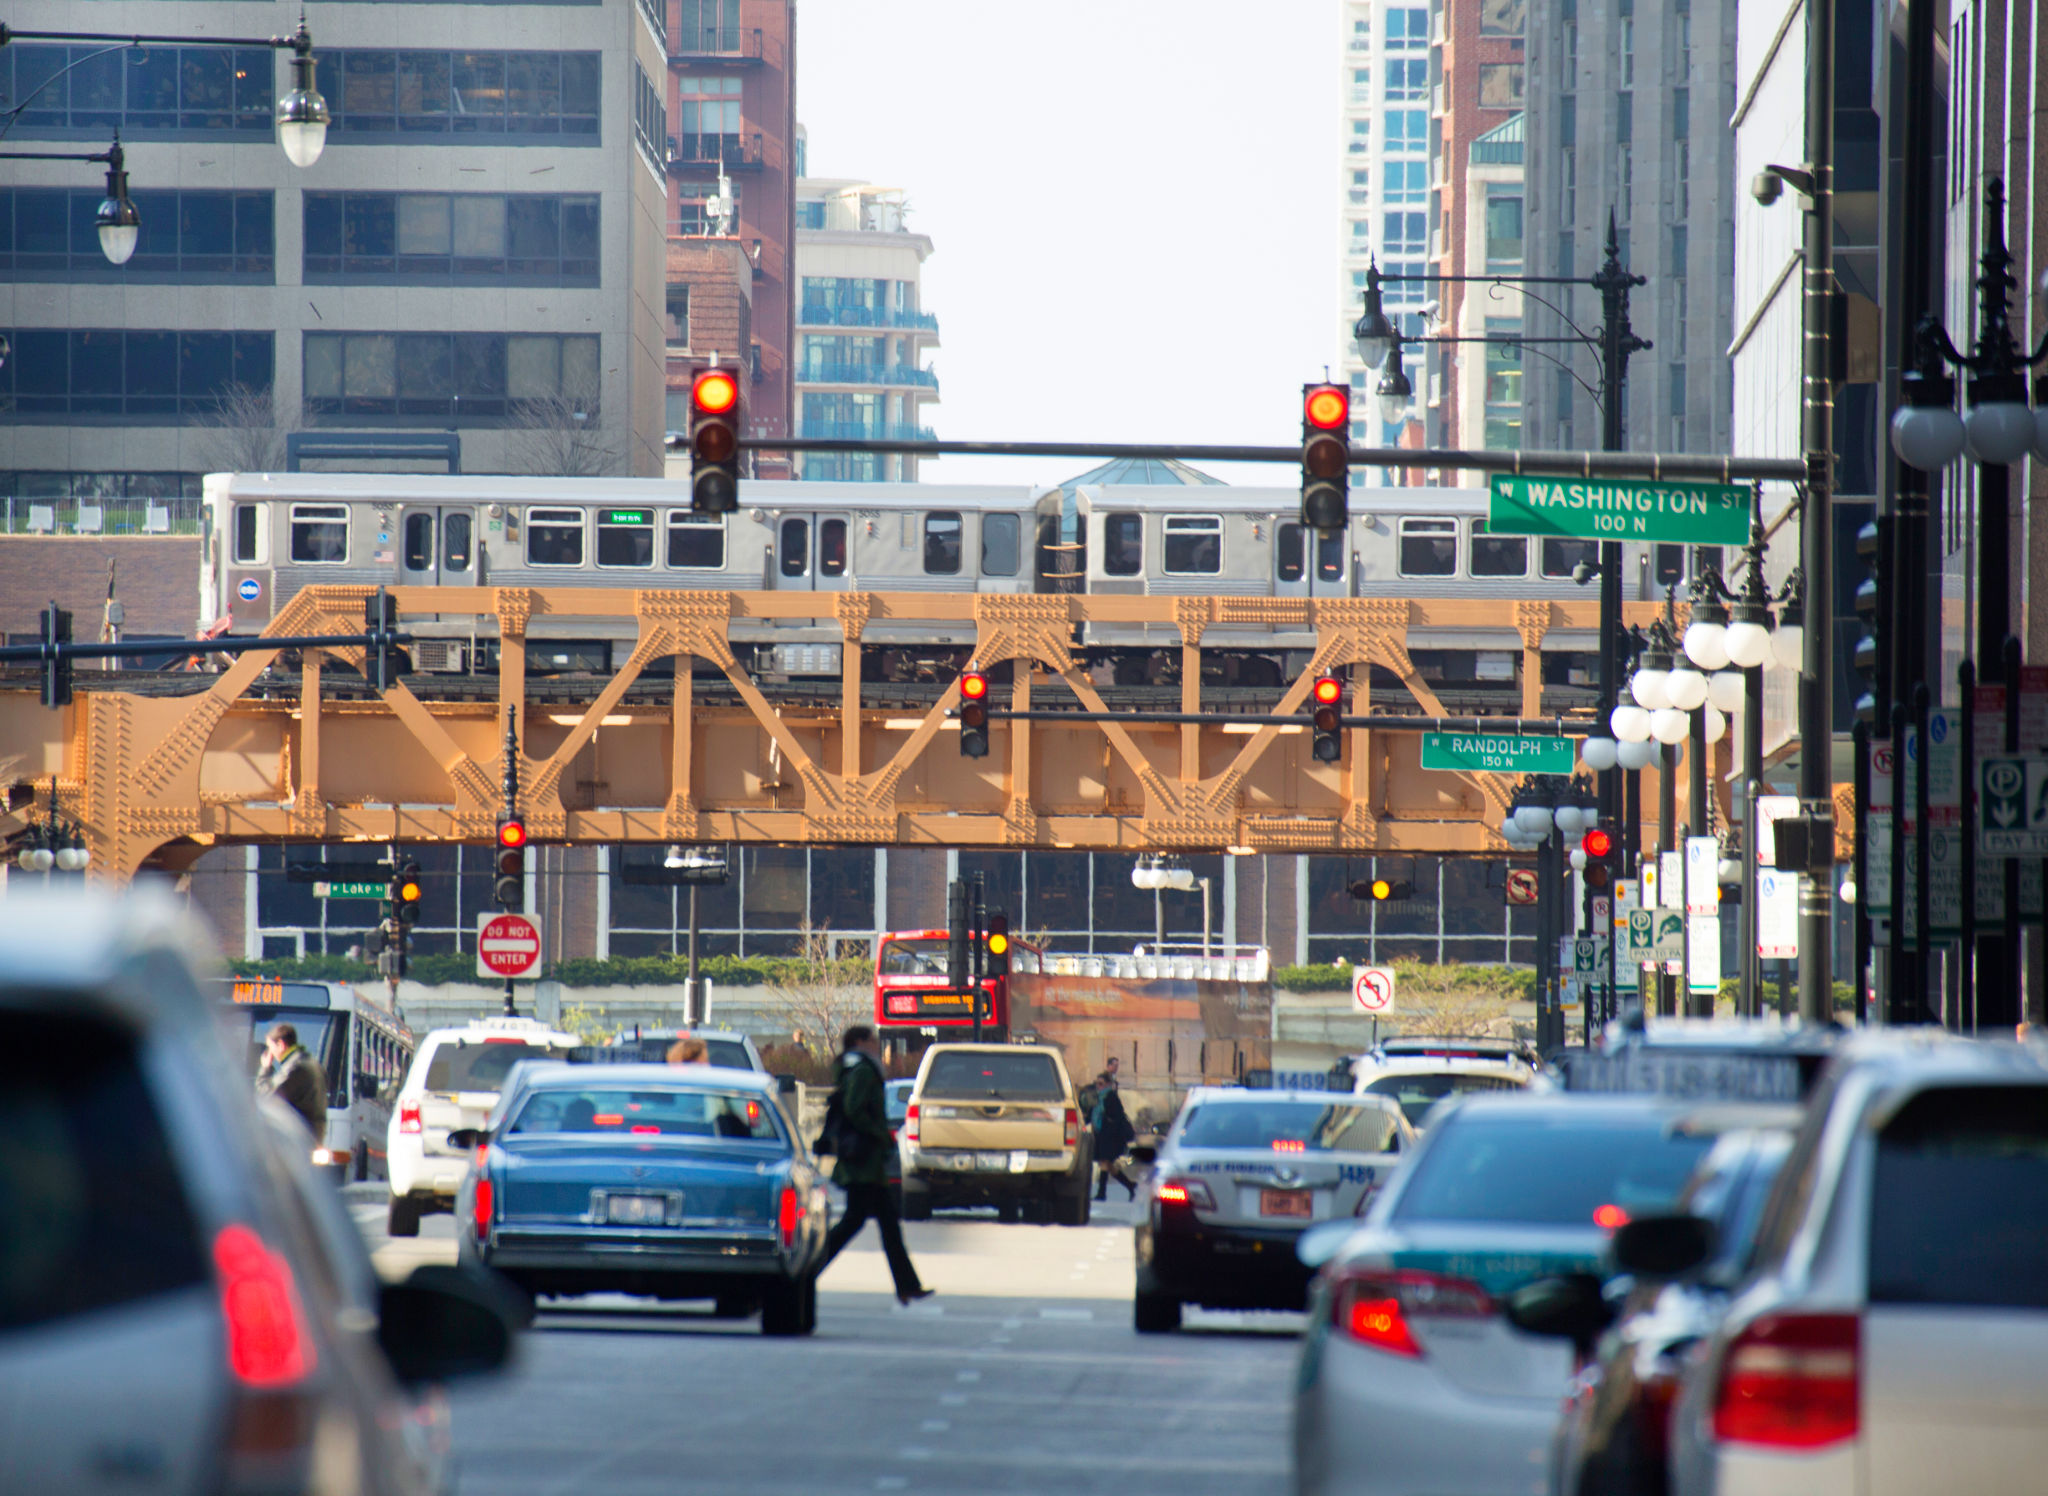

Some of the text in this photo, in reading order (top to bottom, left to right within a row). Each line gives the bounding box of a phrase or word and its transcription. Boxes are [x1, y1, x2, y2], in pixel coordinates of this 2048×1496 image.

[1499, 482, 1743, 515] W WASHINGTON ST
[1594, 514, 1647, 533] 100 N
[1431, 738, 1566, 756] W RANDOLPH ST
[1482, 755, 1514, 767] 150 N
[1991, 833, 2023, 848] PAY
[342, 882, 372, 895] Lake
[487, 925, 531, 938] DO NOT
[491, 953, 527, 965] ENTER
[1633, 949, 1651, 958] PAY
[233, 983, 282, 1004] UNION
[1278, 1071, 1326, 1090] 1489
[1338, 1163, 1376, 1184] 1489
